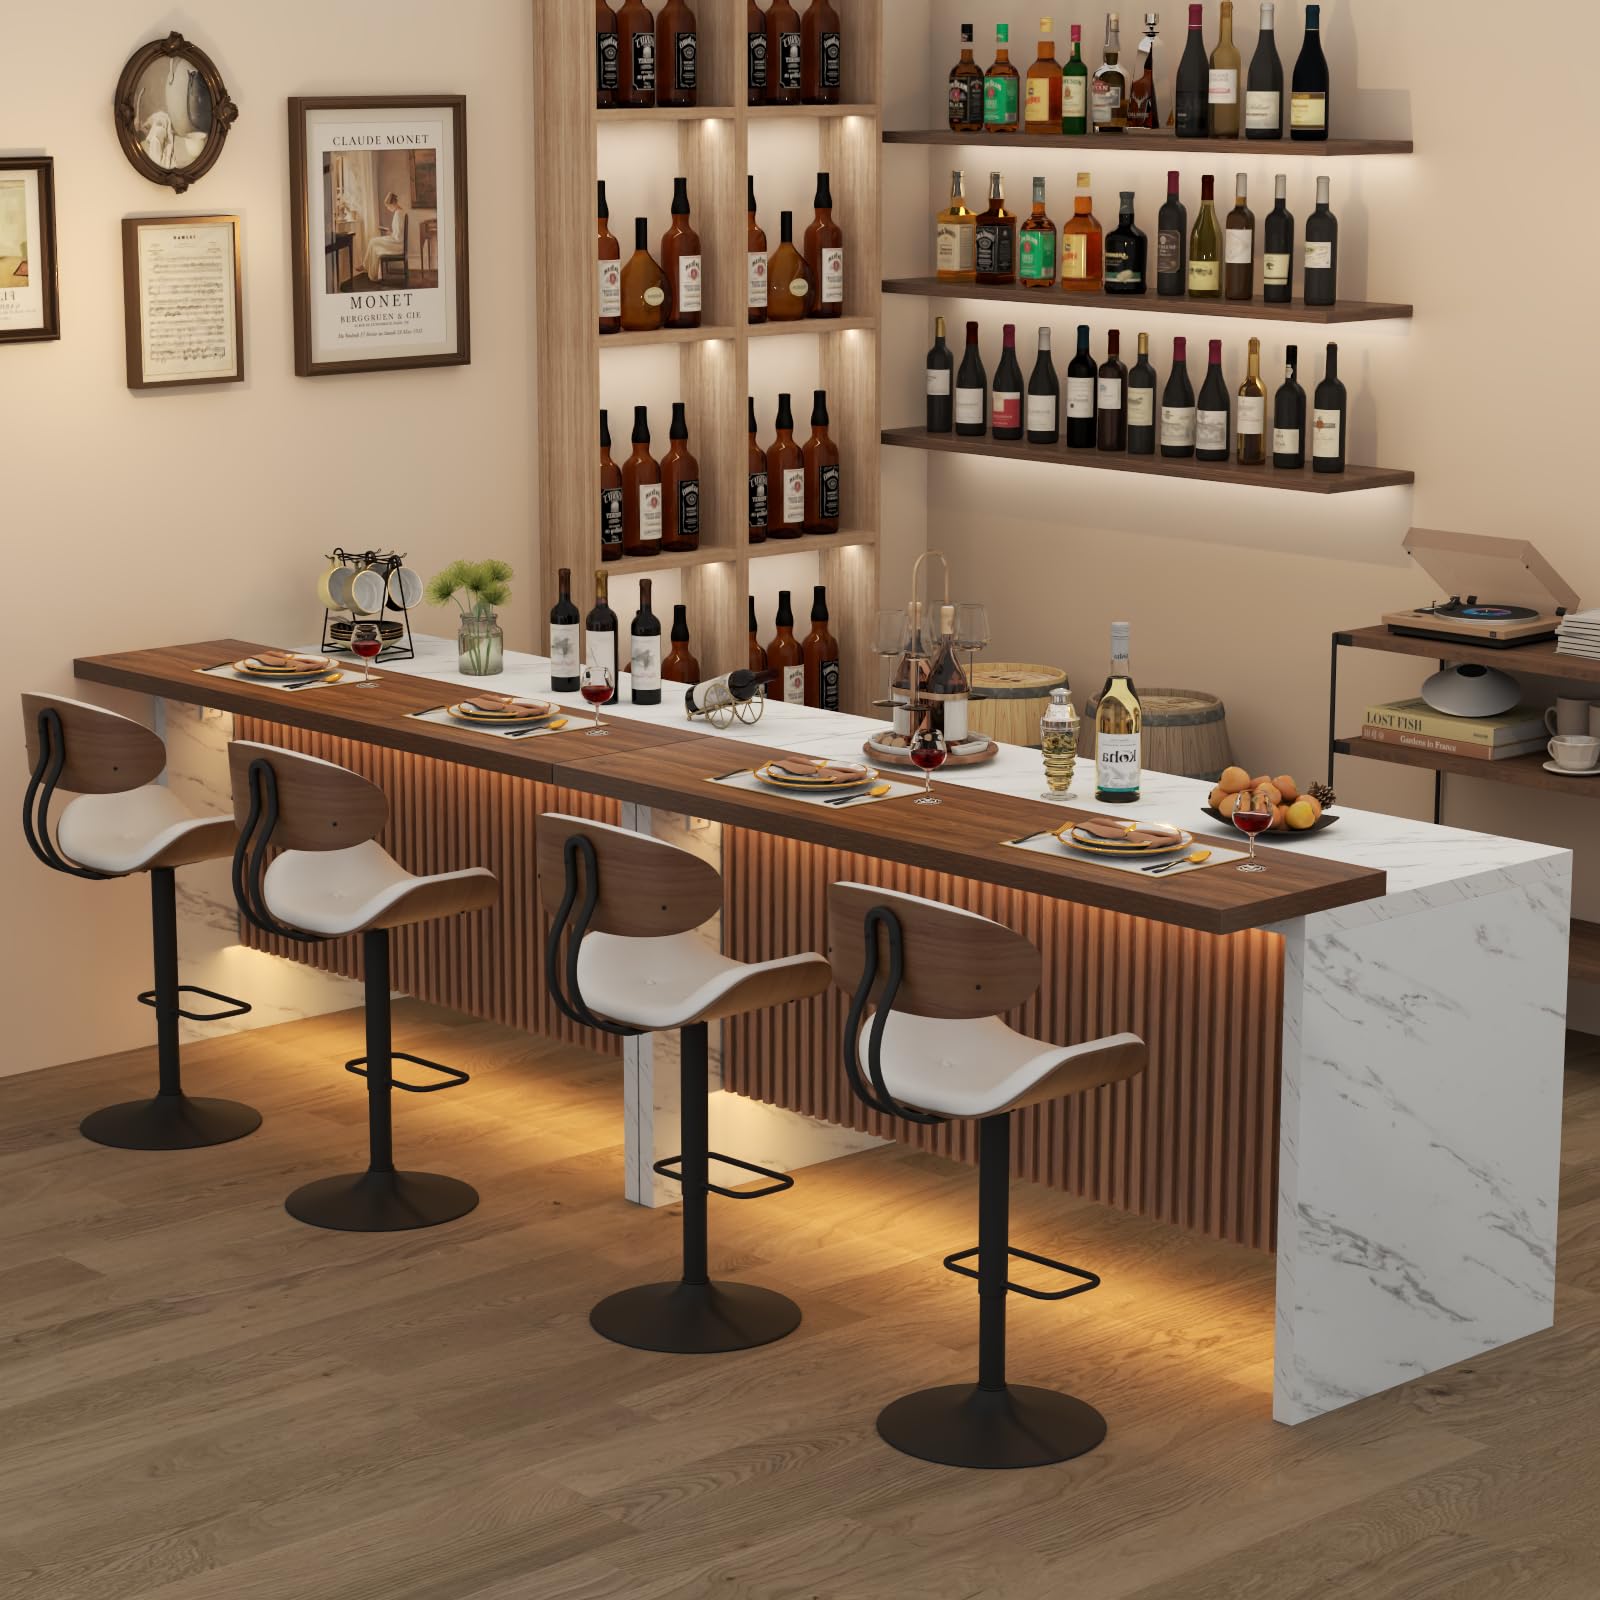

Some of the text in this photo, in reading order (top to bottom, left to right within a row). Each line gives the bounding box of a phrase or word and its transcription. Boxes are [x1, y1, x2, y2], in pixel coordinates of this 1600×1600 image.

[332, 134, 428, 146] CLAUDE MONET
[350, 293, 413, 310] MONET
[1367, 711, 1421, 731] LOST FISH
[1400, 735, 1426, 746] Gardens
[1434, 741, 1457, 753] France
